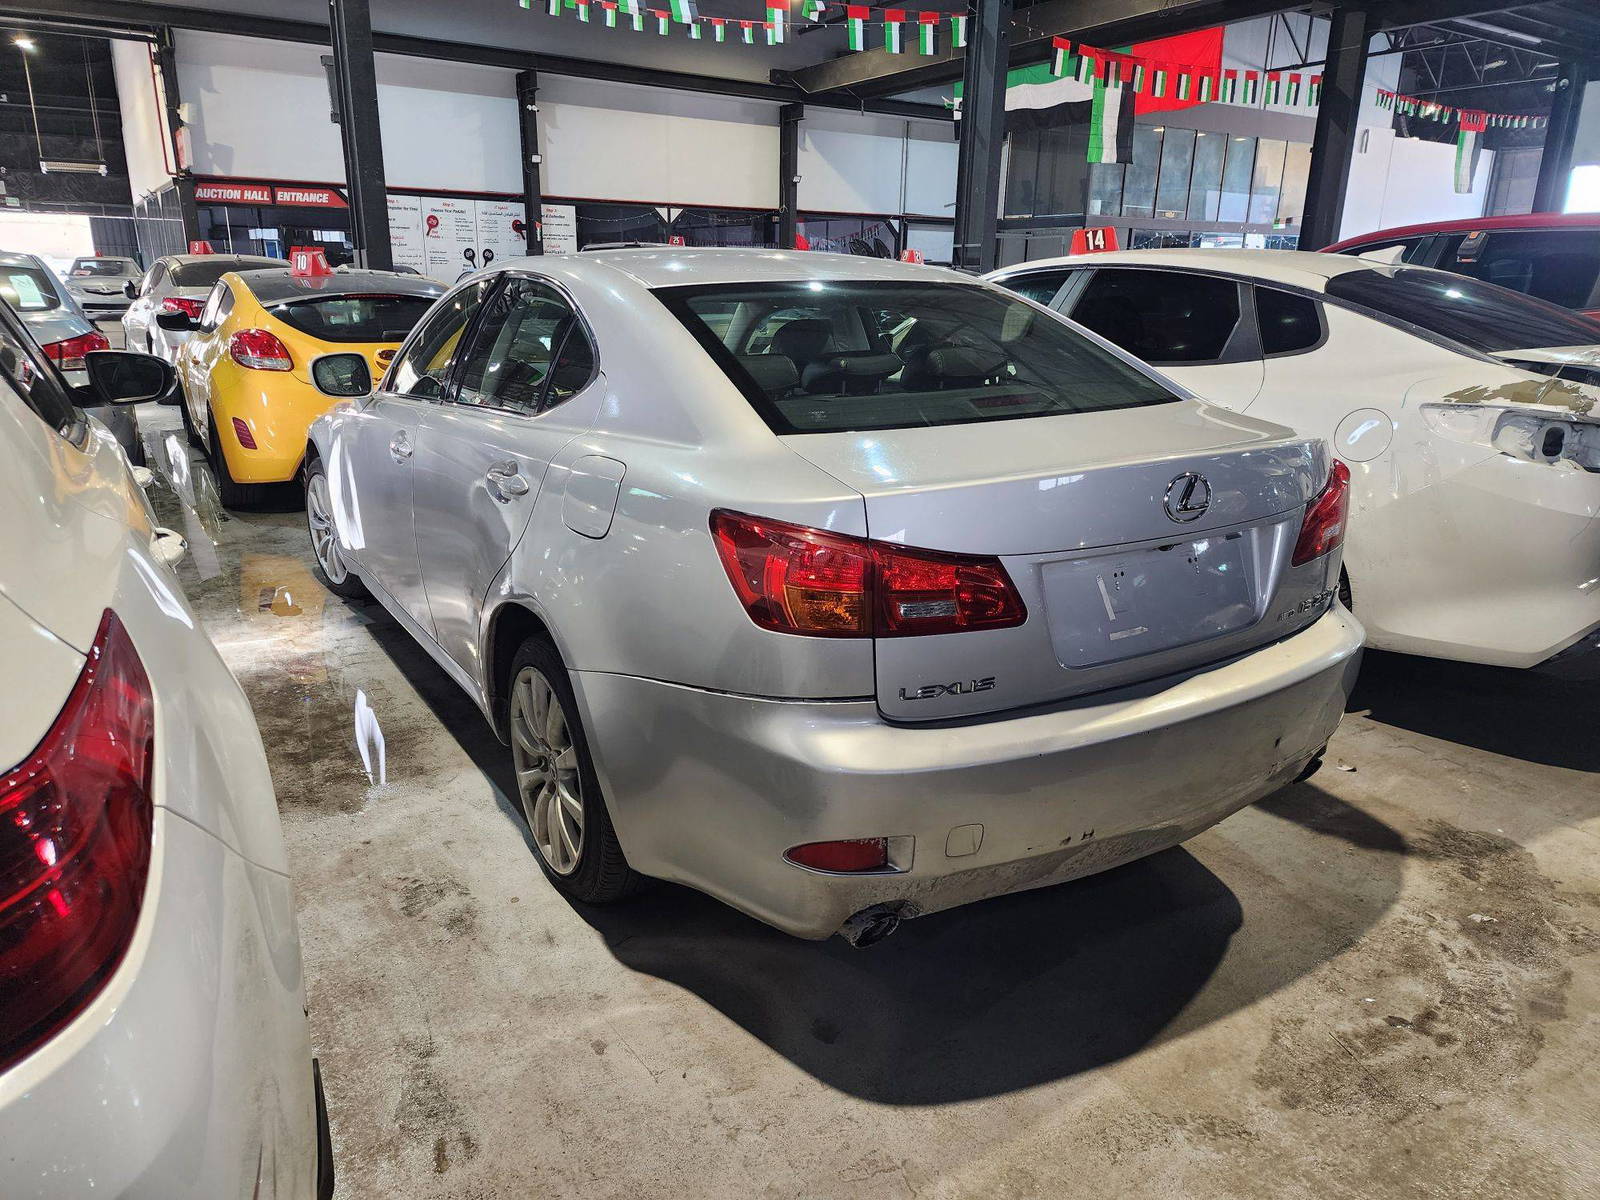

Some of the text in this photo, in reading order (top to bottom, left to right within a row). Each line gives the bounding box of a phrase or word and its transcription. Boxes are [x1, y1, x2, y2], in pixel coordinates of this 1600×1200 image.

[195, 188, 270, 201] AUCTION HALL
[277, 192, 329, 204] ENTRANCE
[194, 242, 199, 252] 3
[1086, 229, 1105, 251] 14
[297, 254, 307, 271] 10
[899, 676, 996, 701] LEXUS
